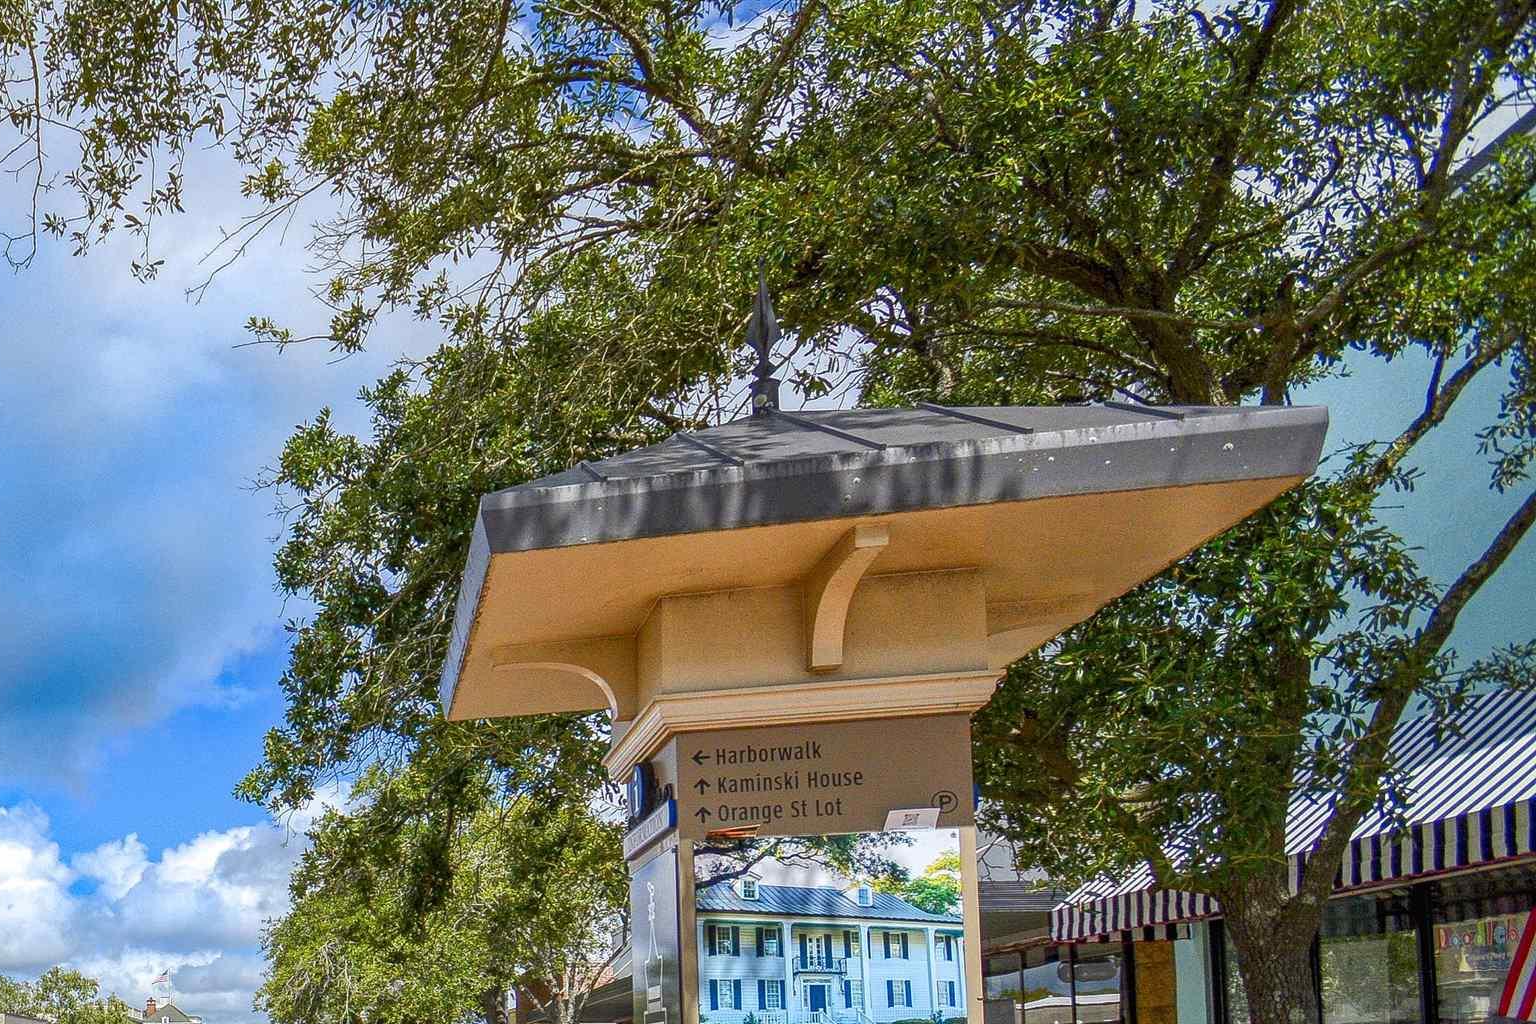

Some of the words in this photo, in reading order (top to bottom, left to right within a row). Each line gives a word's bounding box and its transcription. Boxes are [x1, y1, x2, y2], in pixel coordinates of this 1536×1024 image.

[715, 742, 822, 765] Harborwalk
[717, 771, 800, 794] Kaminski
[807, 769, 864, 788] House
[717, 801, 784, 824] Orange
[791, 800, 808, 817] St
[815, 797, 843, 817] Lot
